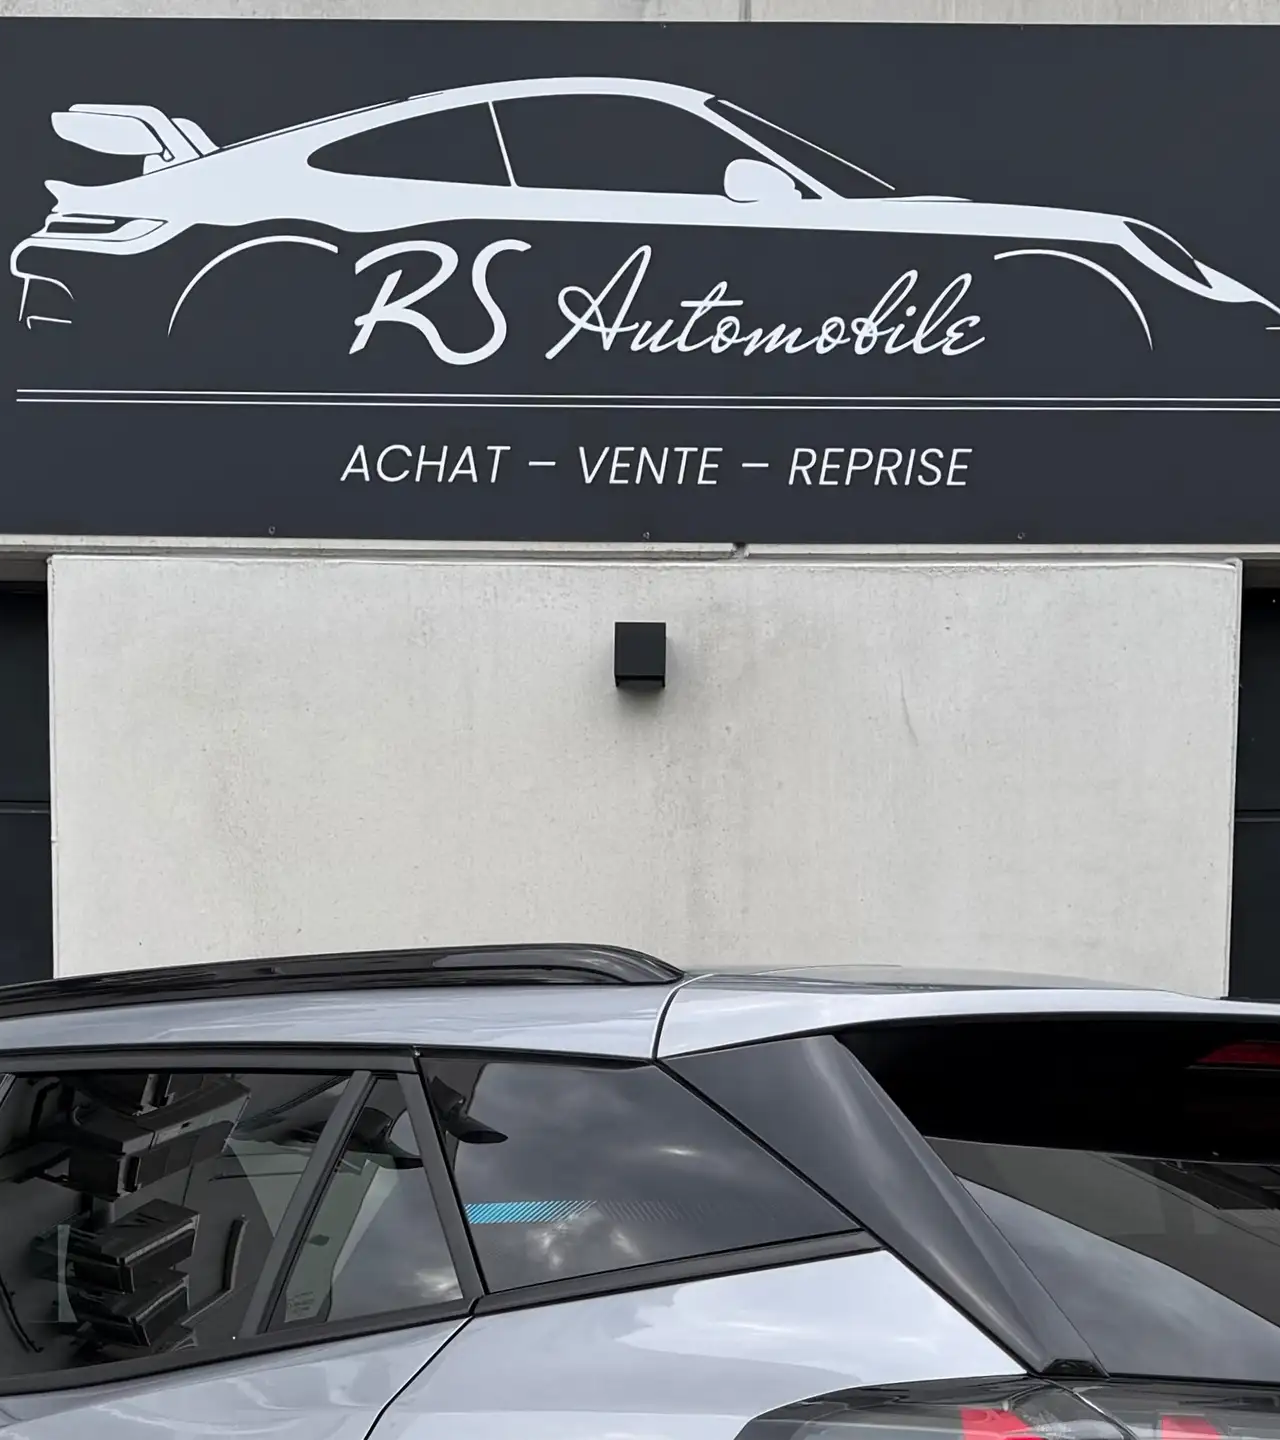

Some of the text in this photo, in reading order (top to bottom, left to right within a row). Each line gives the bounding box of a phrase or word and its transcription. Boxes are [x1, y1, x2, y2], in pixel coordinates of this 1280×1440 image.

[349, 239, 985, 365] RS Automobile
[340, 445, 511, 483] ACHAT
[579, 447, 723, 484] VENTE
[789, 448, 972, 485] REPRISE
